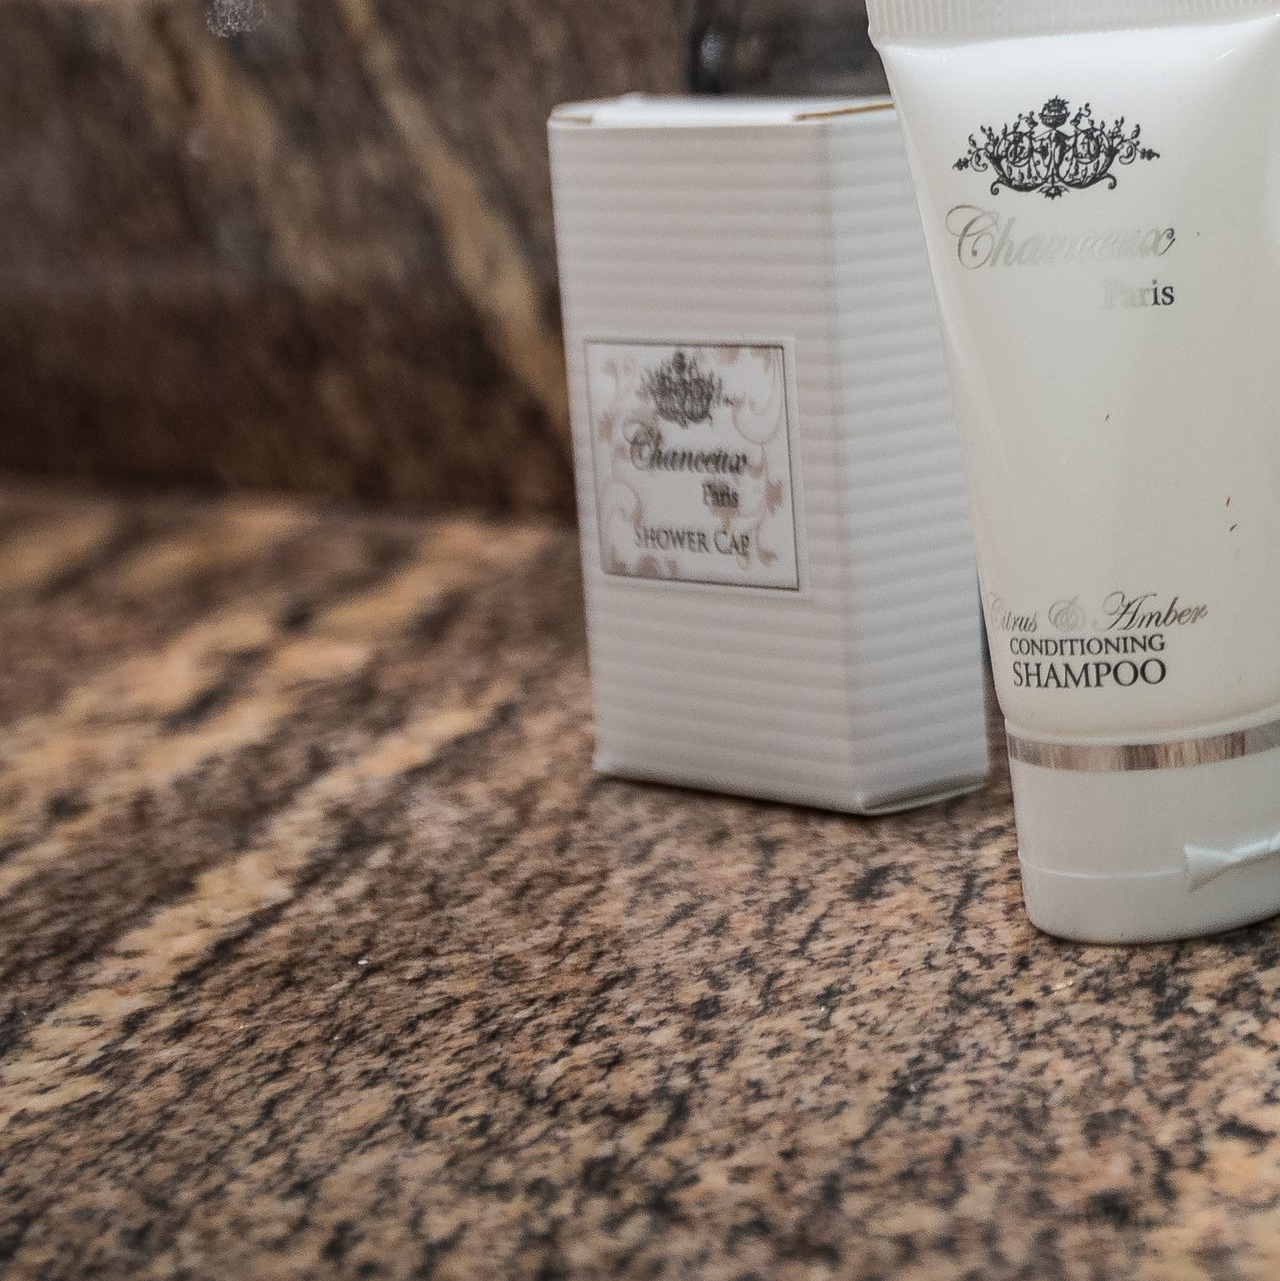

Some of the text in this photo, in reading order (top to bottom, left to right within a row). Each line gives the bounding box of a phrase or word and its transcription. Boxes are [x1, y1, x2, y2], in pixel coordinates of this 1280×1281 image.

[623, 418, 748, 475] Chanceux
[702, 479, 740, 509] Paris
[714, 530, 750, 557] CAP
[1097, 590, 1208, 633] Amber
[1009, 633, 1166, 657] CONDITIONING
[1012, 658, 1167, 689] SHAMPOO
